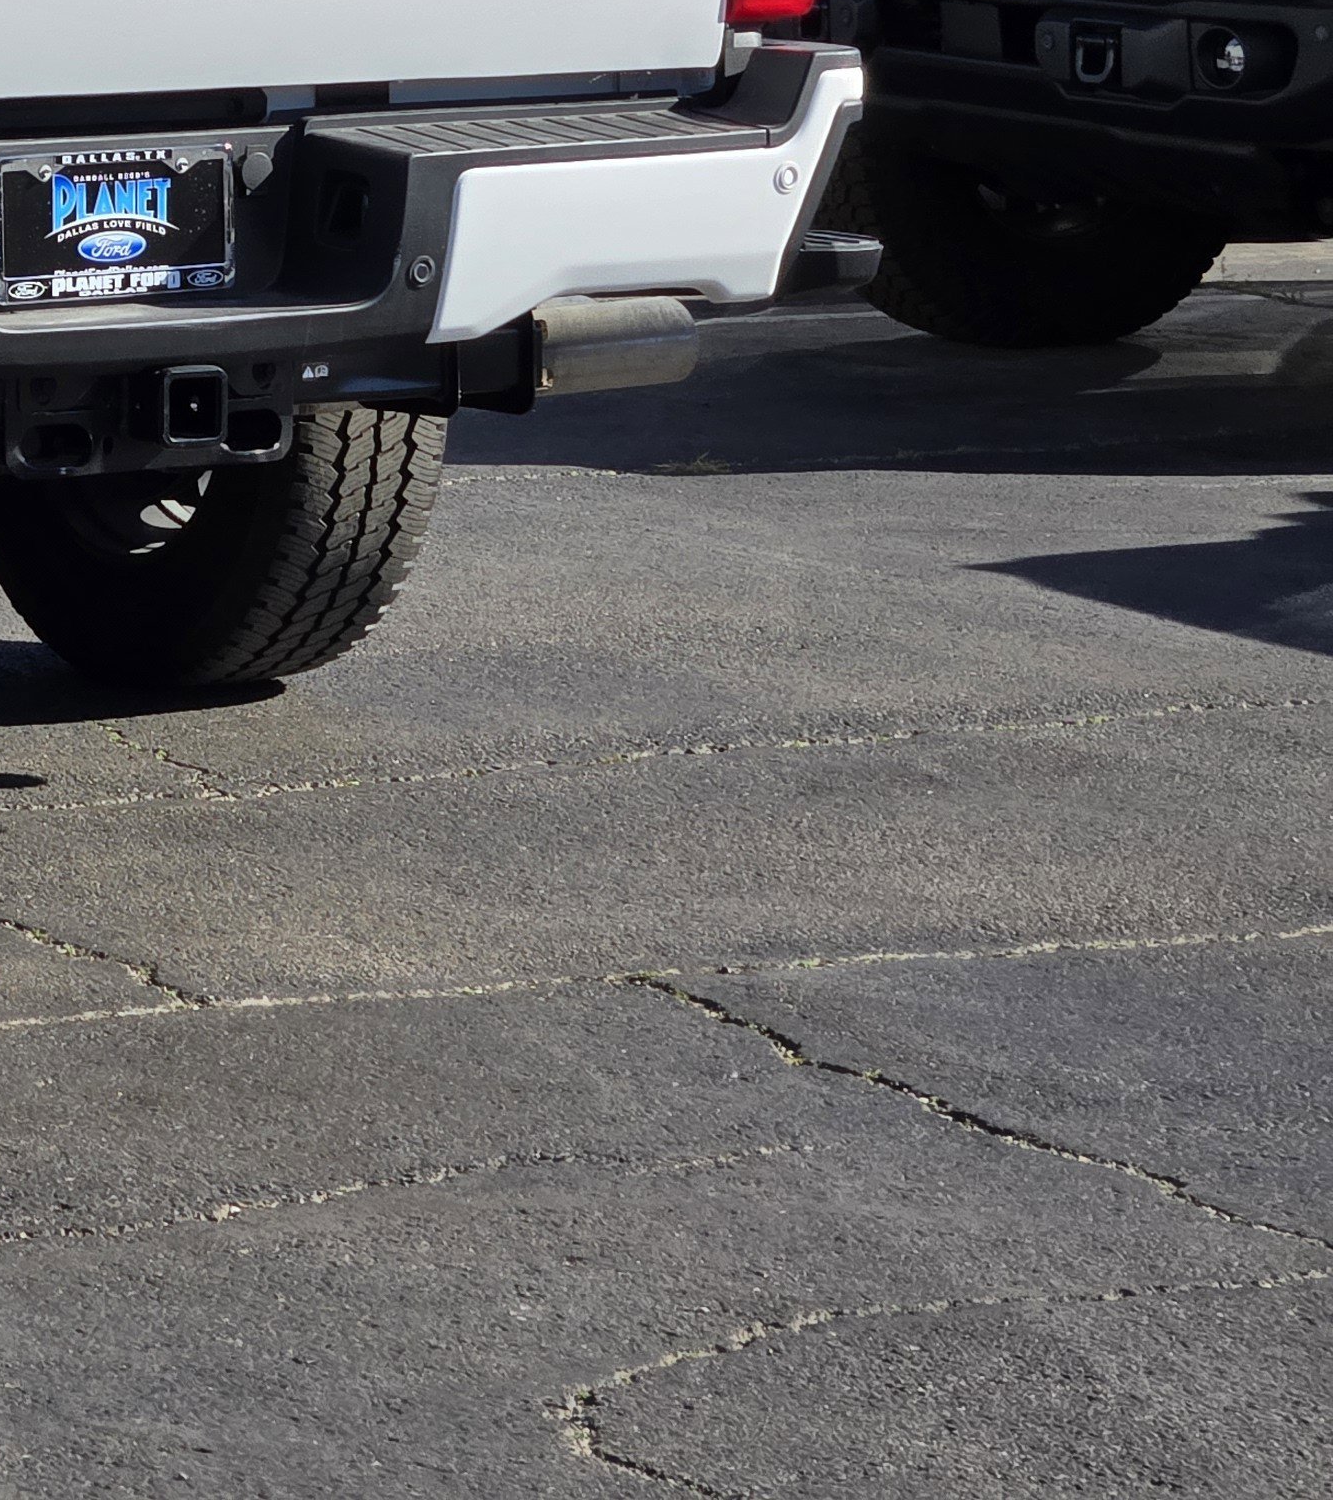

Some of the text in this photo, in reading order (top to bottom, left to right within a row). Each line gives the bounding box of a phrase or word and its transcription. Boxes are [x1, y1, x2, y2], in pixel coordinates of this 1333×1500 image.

[52, 173, 172, 232] PLANET
[57, 219, 167, 243] DALLAS LOVE FIELD
[91, 238, 133, 258] Ford
[52, 270, 181, 297] PLANET FORD
